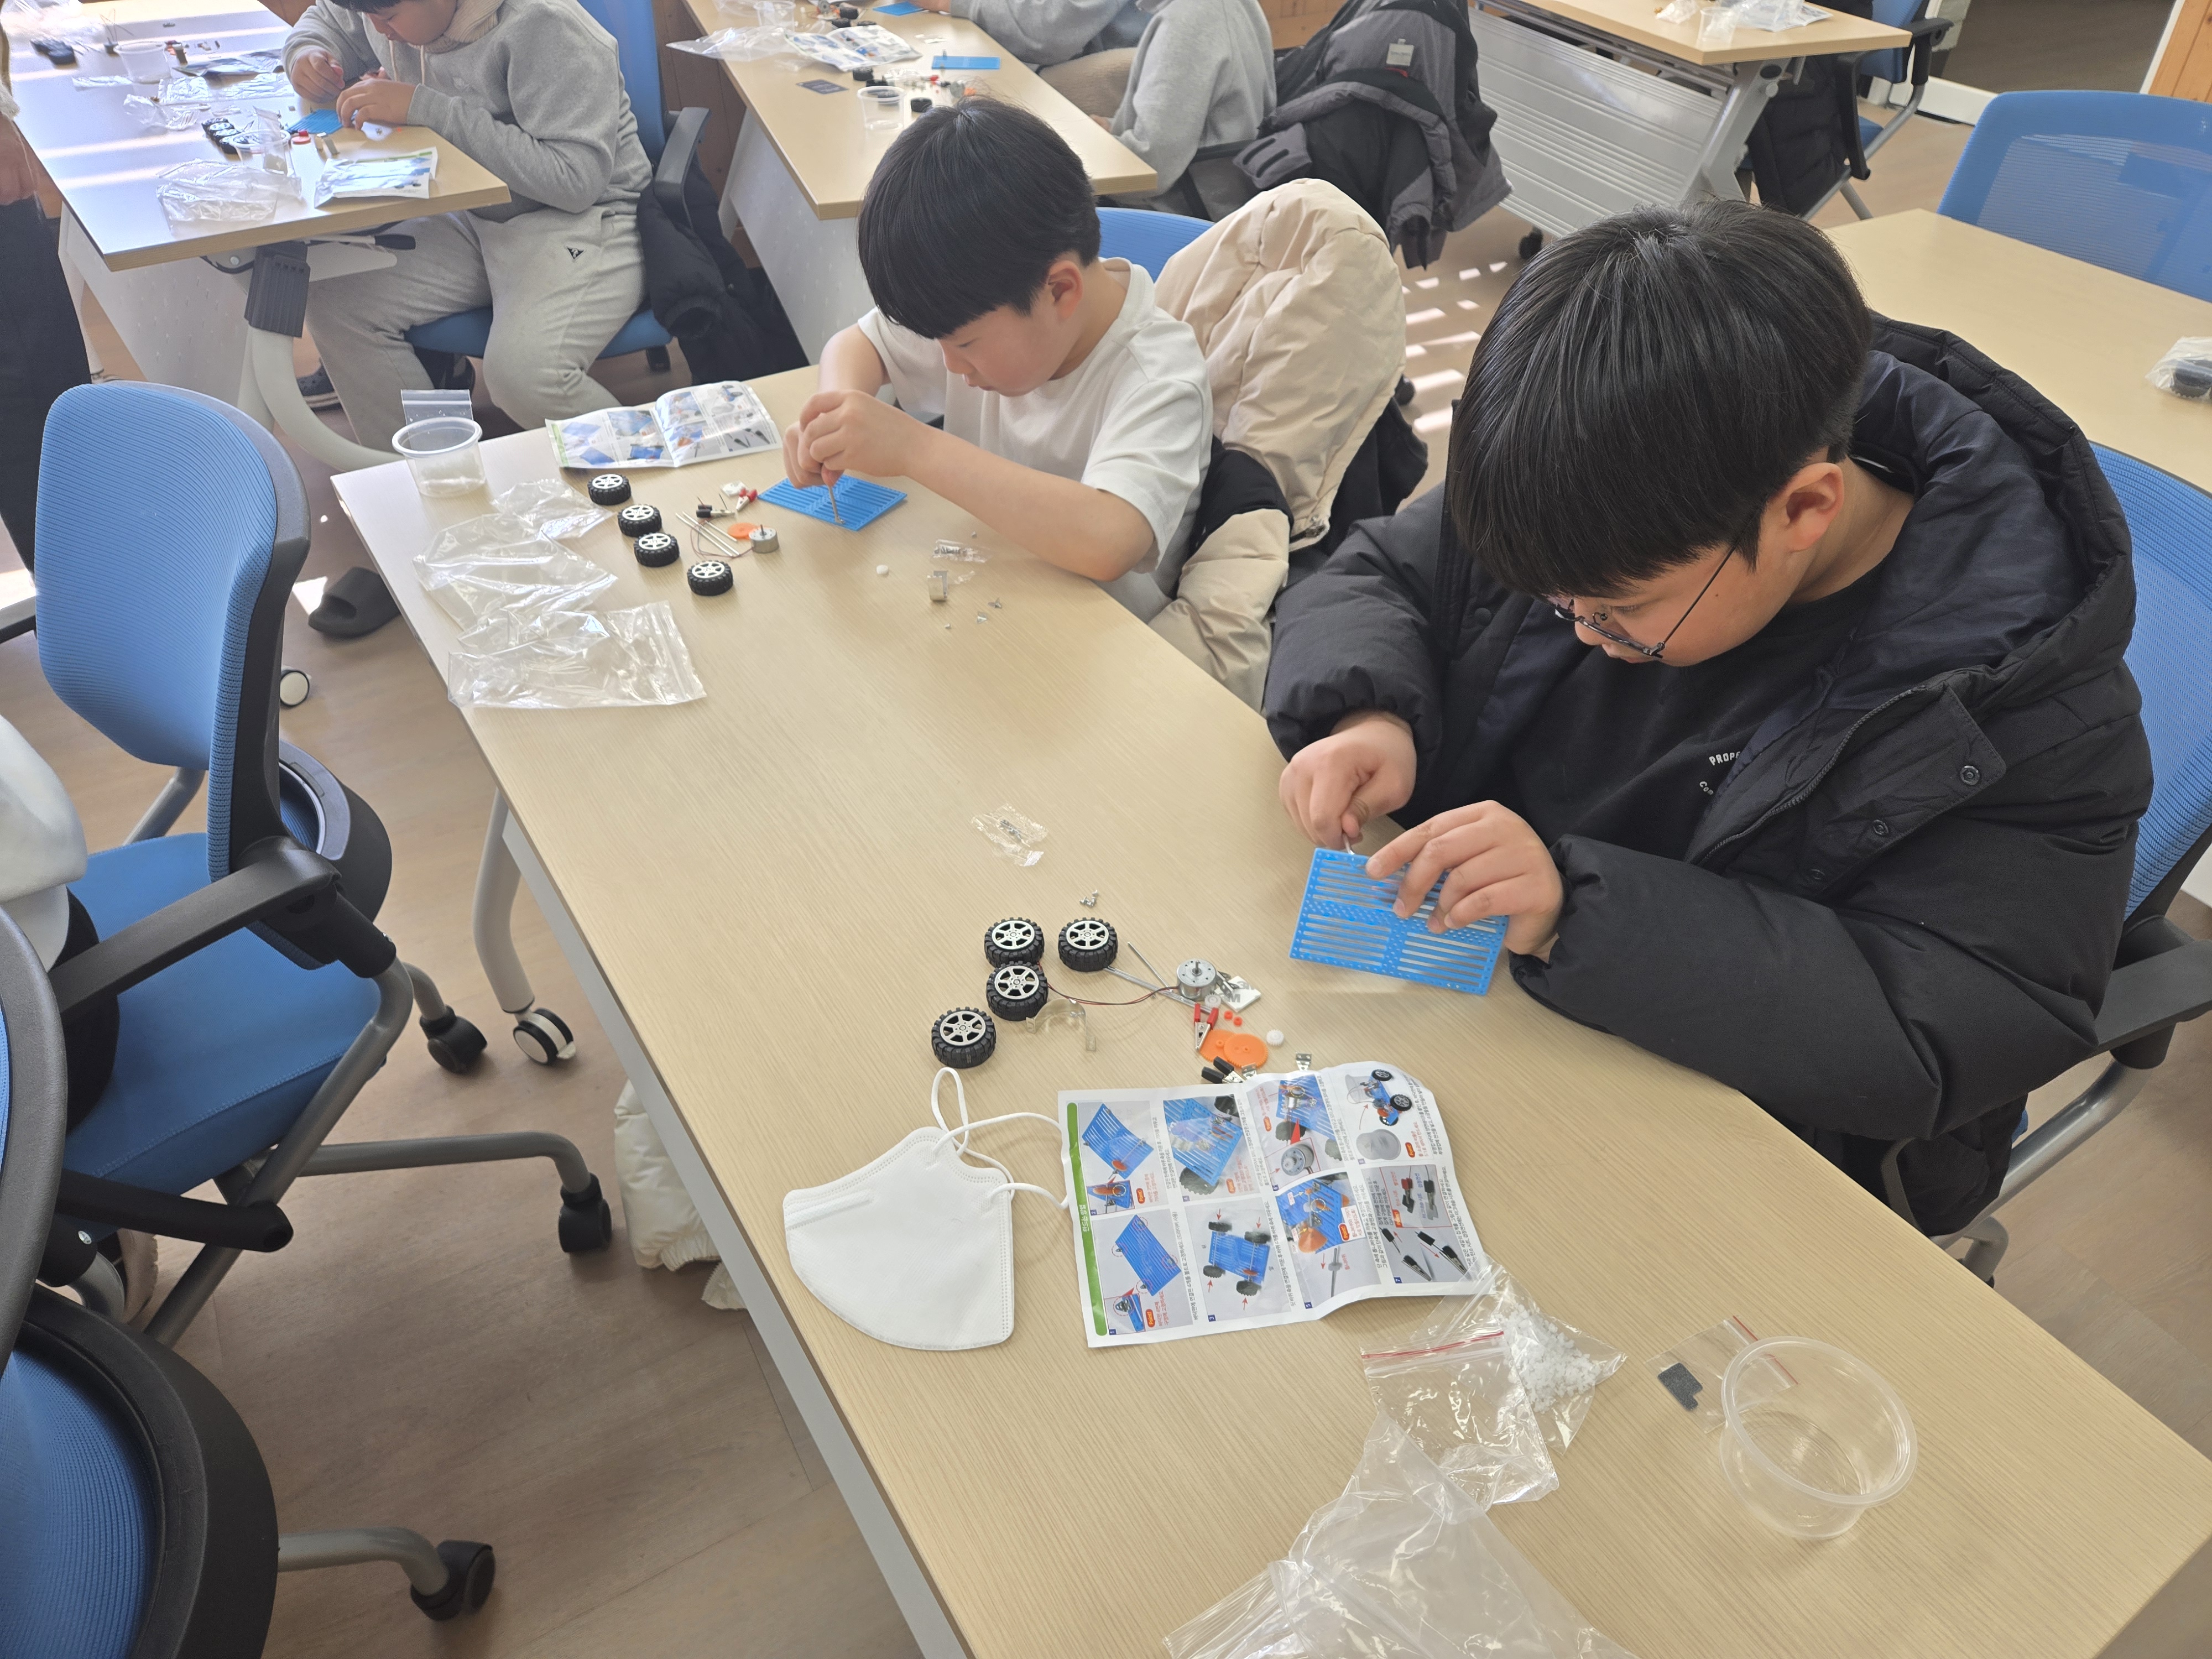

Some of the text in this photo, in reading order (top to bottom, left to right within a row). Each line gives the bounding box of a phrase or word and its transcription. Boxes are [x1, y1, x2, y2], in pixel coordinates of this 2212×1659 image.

[1445, 1200, 1451, 1209] 같이
[1079, 1203, 1089, 1232] 만드는 방법
[1448, 1209, 1456, 1223] 그림과
[1388, 1217, 1394, 1225] 다시
[1270, 1225, 1276, 1234] 바퀴
[1366, 1231, 1378, 1253] 톱니바퀴를
[1275, 1244, 1281, 1253] 바퀴
[1377, 1244, 1383, 1254] 같이
[1462, 1248, 1469, 1258] 같은
[1468, 1247, 1475, 1256] 탄소
[1288, 1292, 1294, 1301] 바퀴
